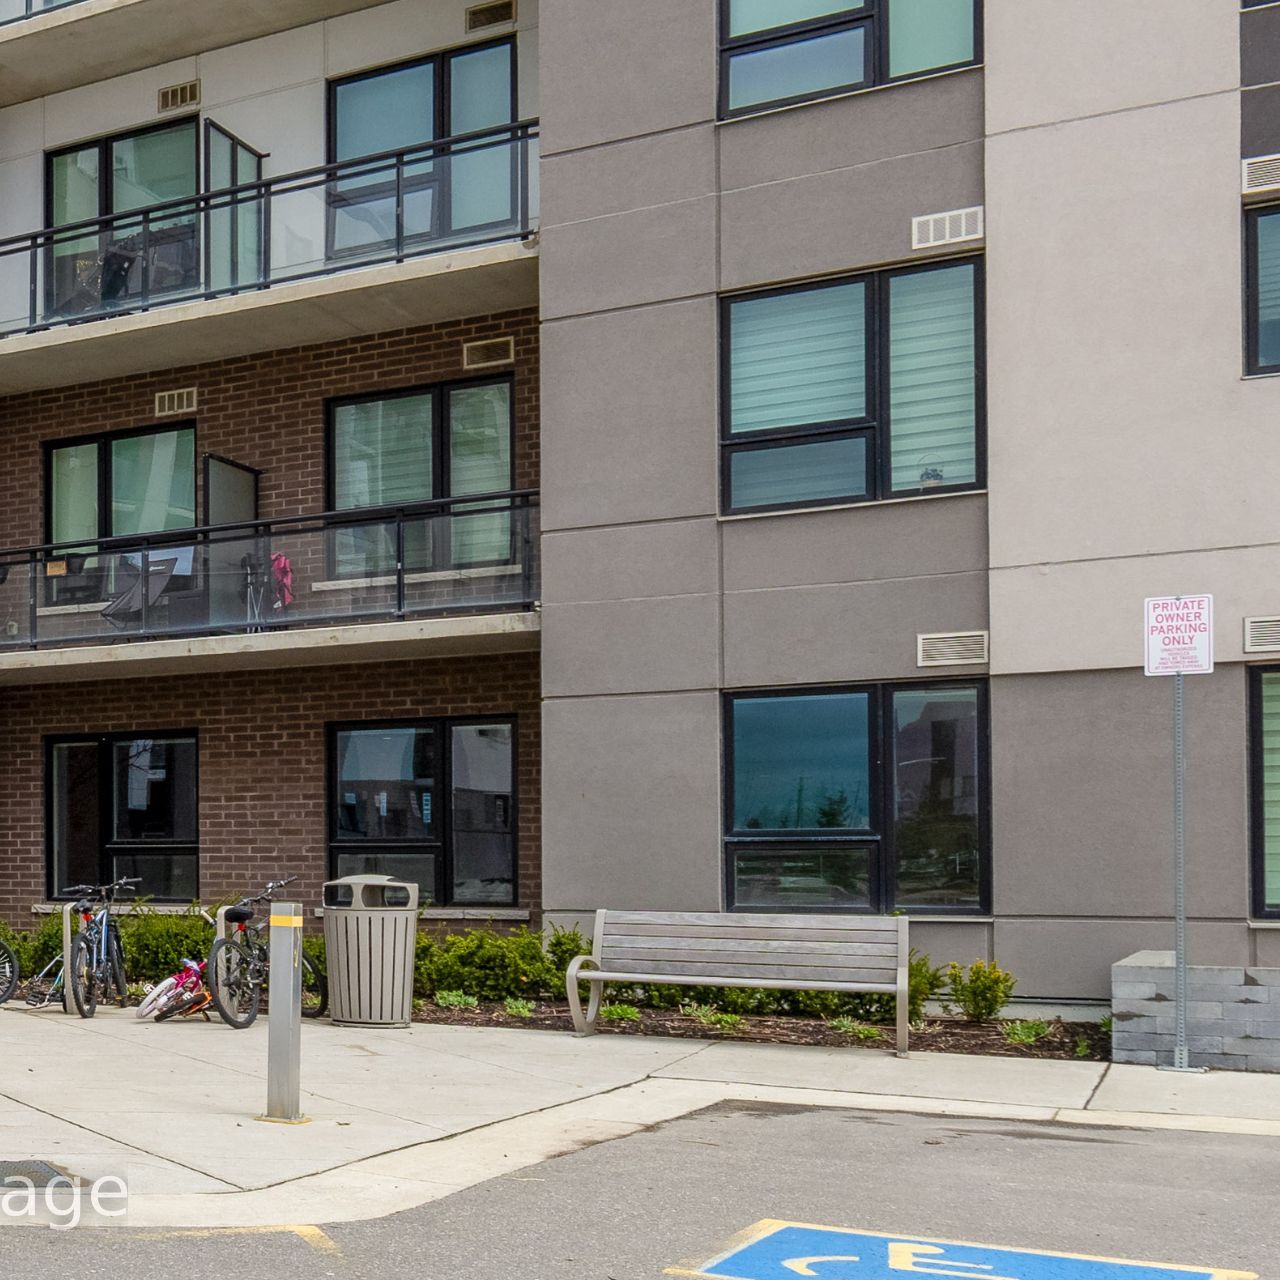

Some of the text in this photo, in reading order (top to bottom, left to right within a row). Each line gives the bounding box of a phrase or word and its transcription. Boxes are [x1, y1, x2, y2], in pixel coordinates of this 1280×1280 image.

[1152, 600, 1205, 613] PRIVATE
[1155, 611, 1202, 624] OWNER
[1150, 622, 1208, 635] PARKING
[1162, 635, 1195, 646] ONLY
